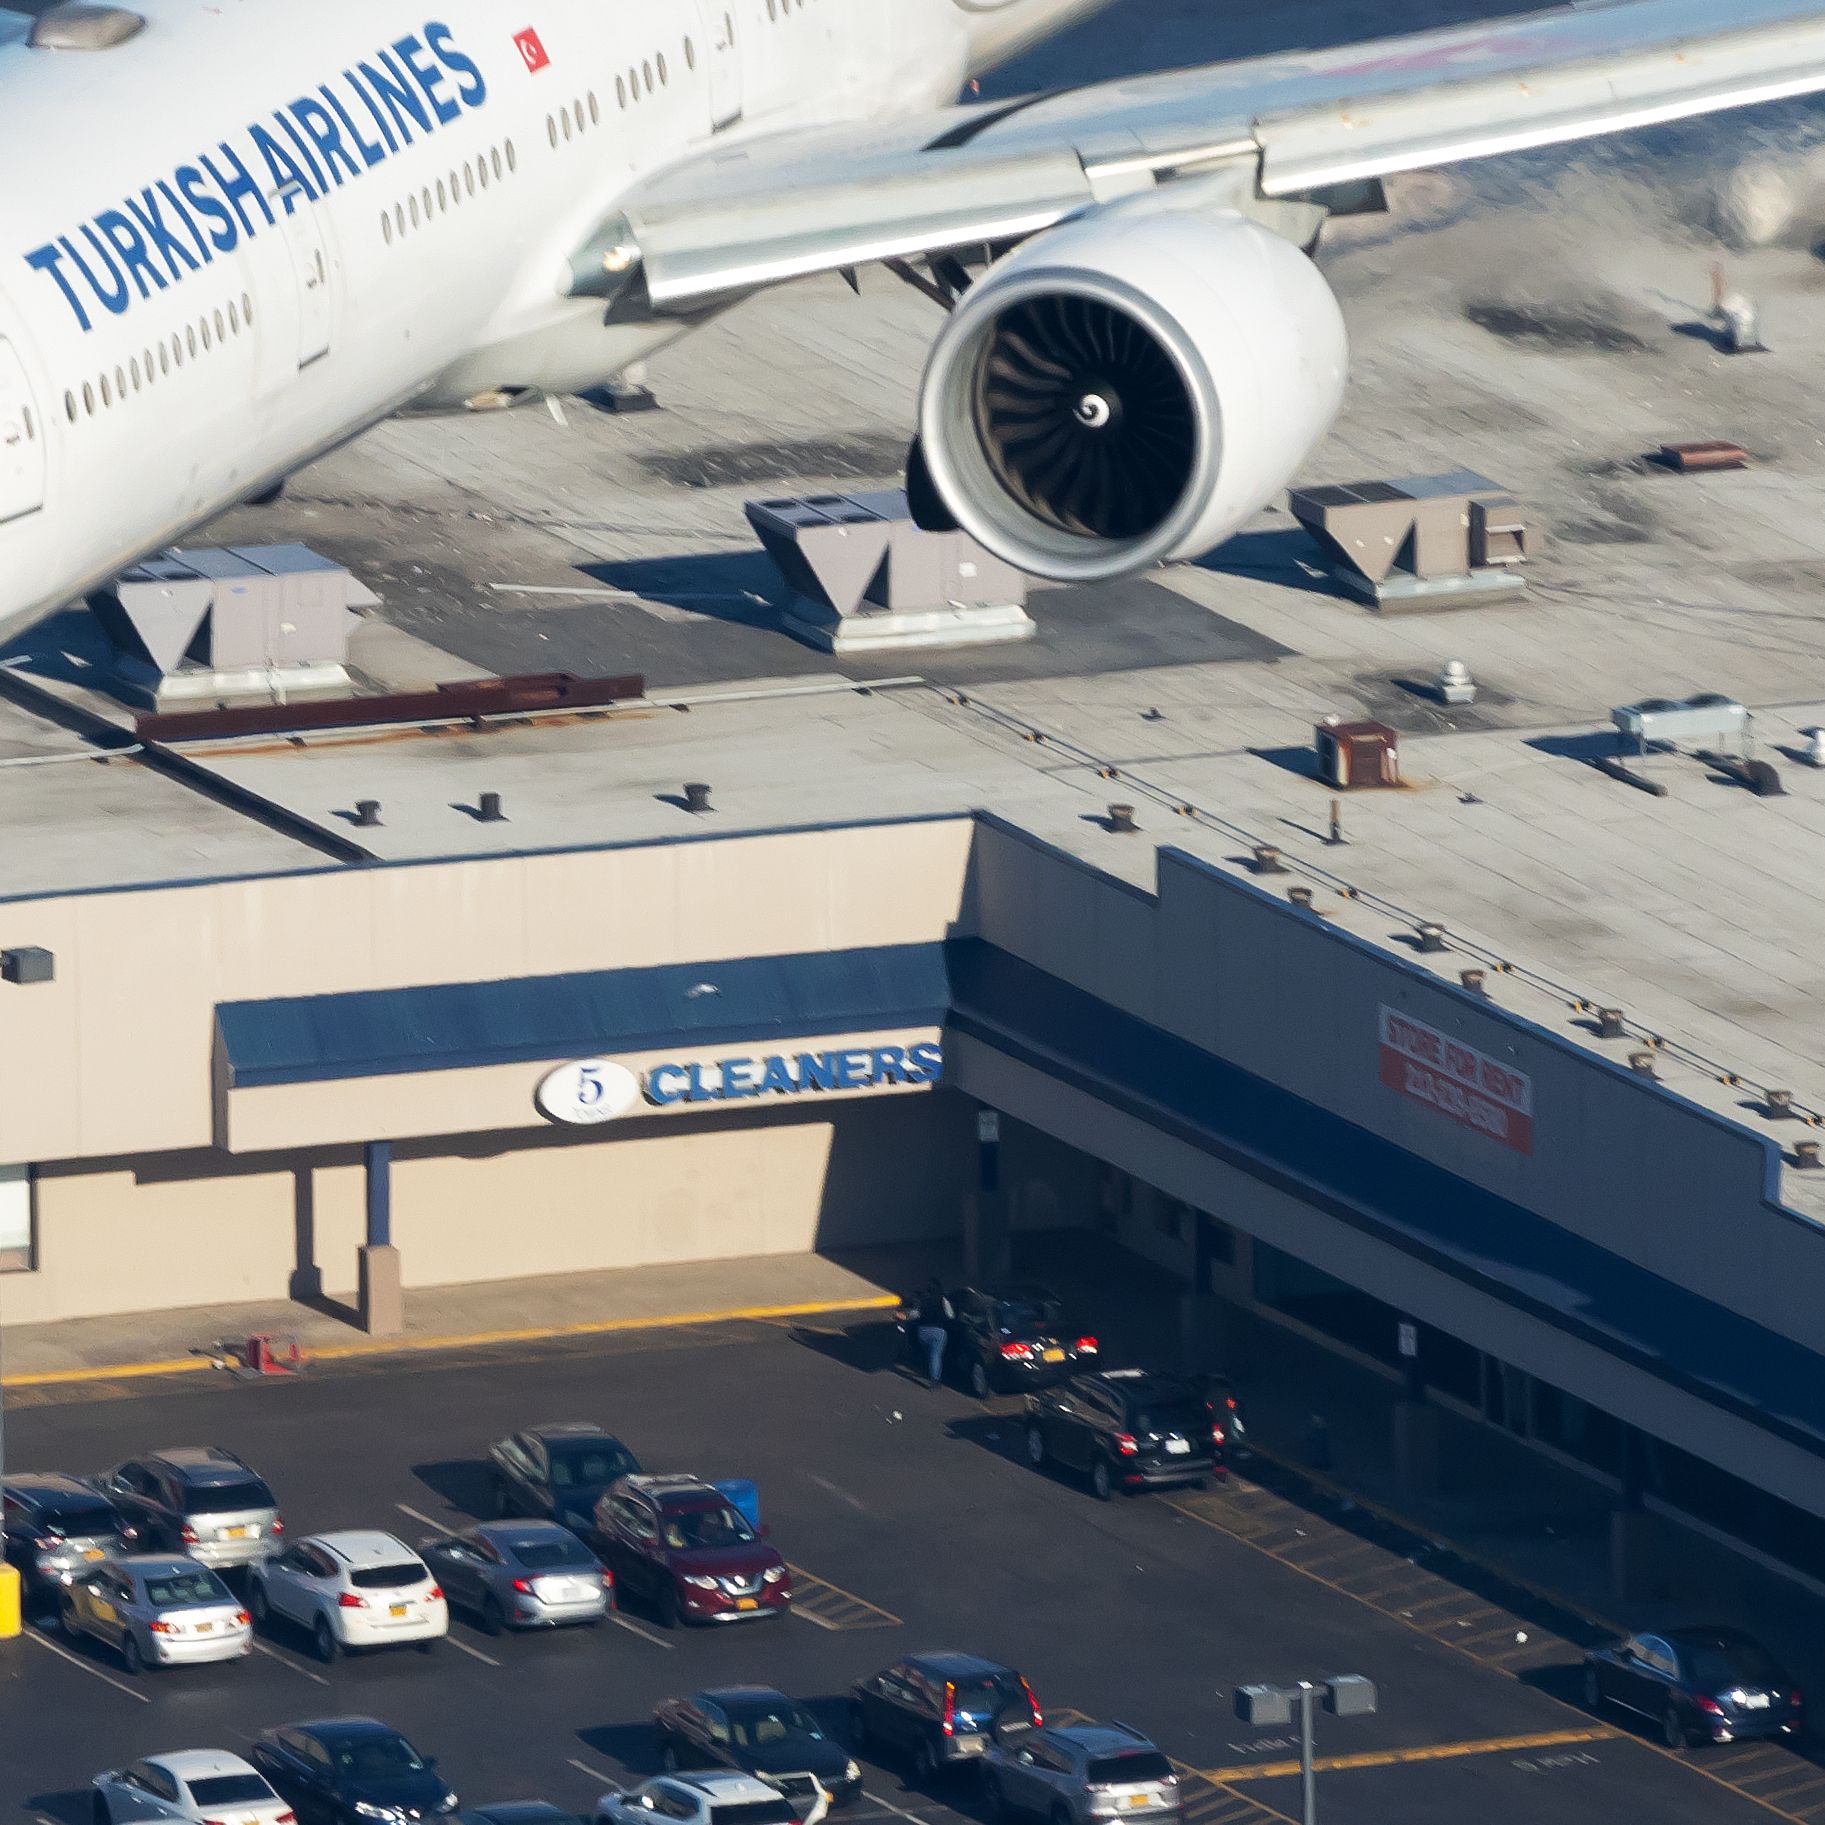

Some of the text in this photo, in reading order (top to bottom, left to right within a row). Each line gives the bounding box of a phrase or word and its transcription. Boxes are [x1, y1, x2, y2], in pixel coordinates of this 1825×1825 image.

[23, 20, 487, 333] TURKISH AIRLINES
[577, 1042, 944, 1105] 5 CLEANERS
